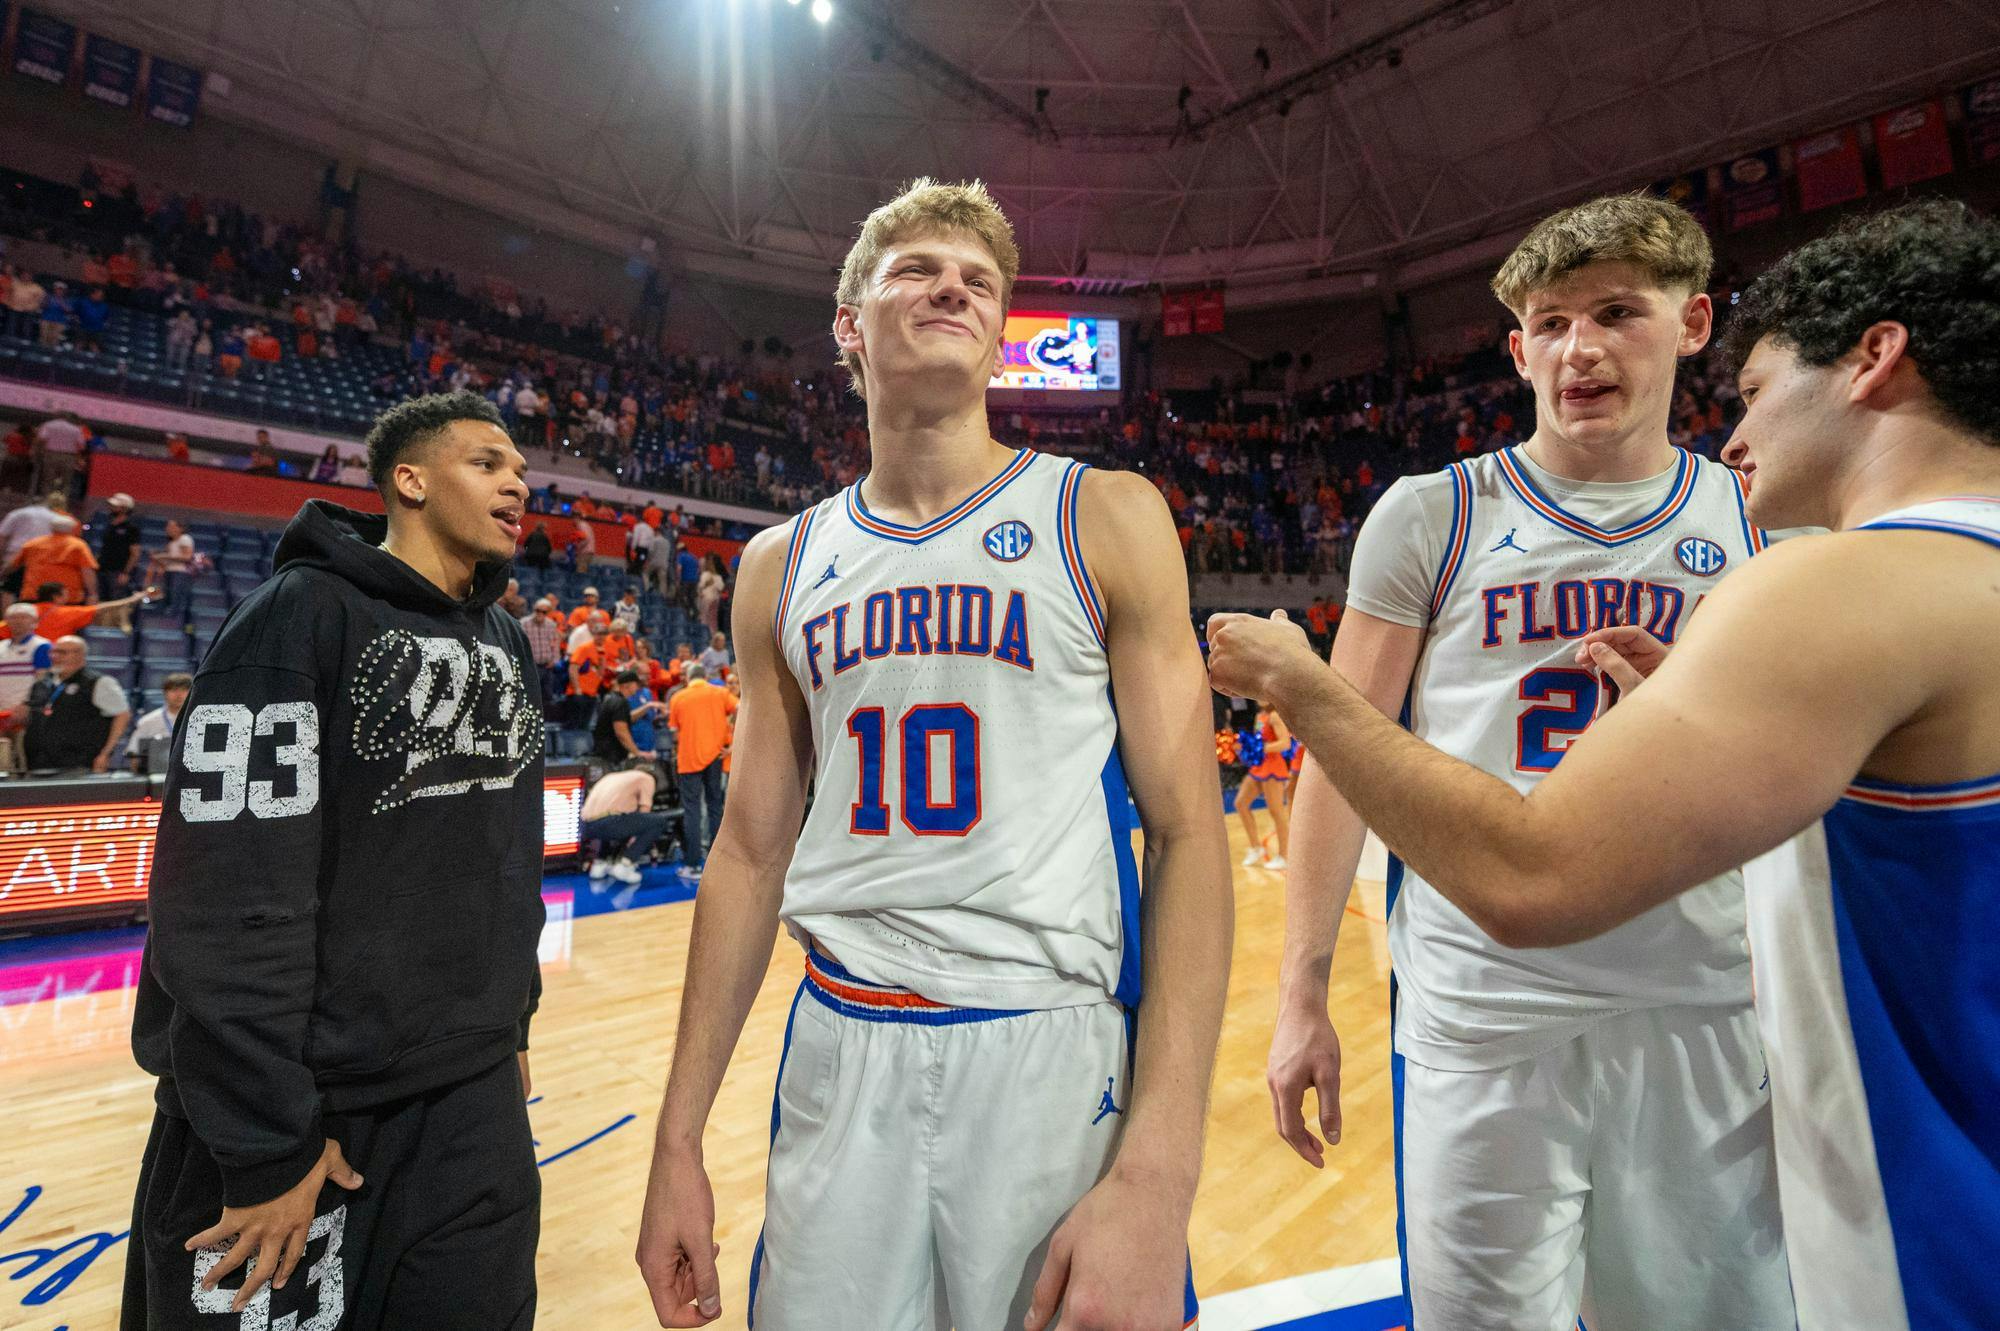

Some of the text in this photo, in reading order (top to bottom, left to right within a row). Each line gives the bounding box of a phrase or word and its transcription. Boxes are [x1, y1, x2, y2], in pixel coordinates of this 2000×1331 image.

[987, 523, 1029, 559] SEC
[1680, 538, 1722, 574] SEC
[802, 584, 1035, 692] FLORIDA
[1481, 577, 1706, 649] FLORID
[179, 701, 320, 823] 93
[846, 702, 982, 837] 10
[1515, 667, 1622, 774] 2
